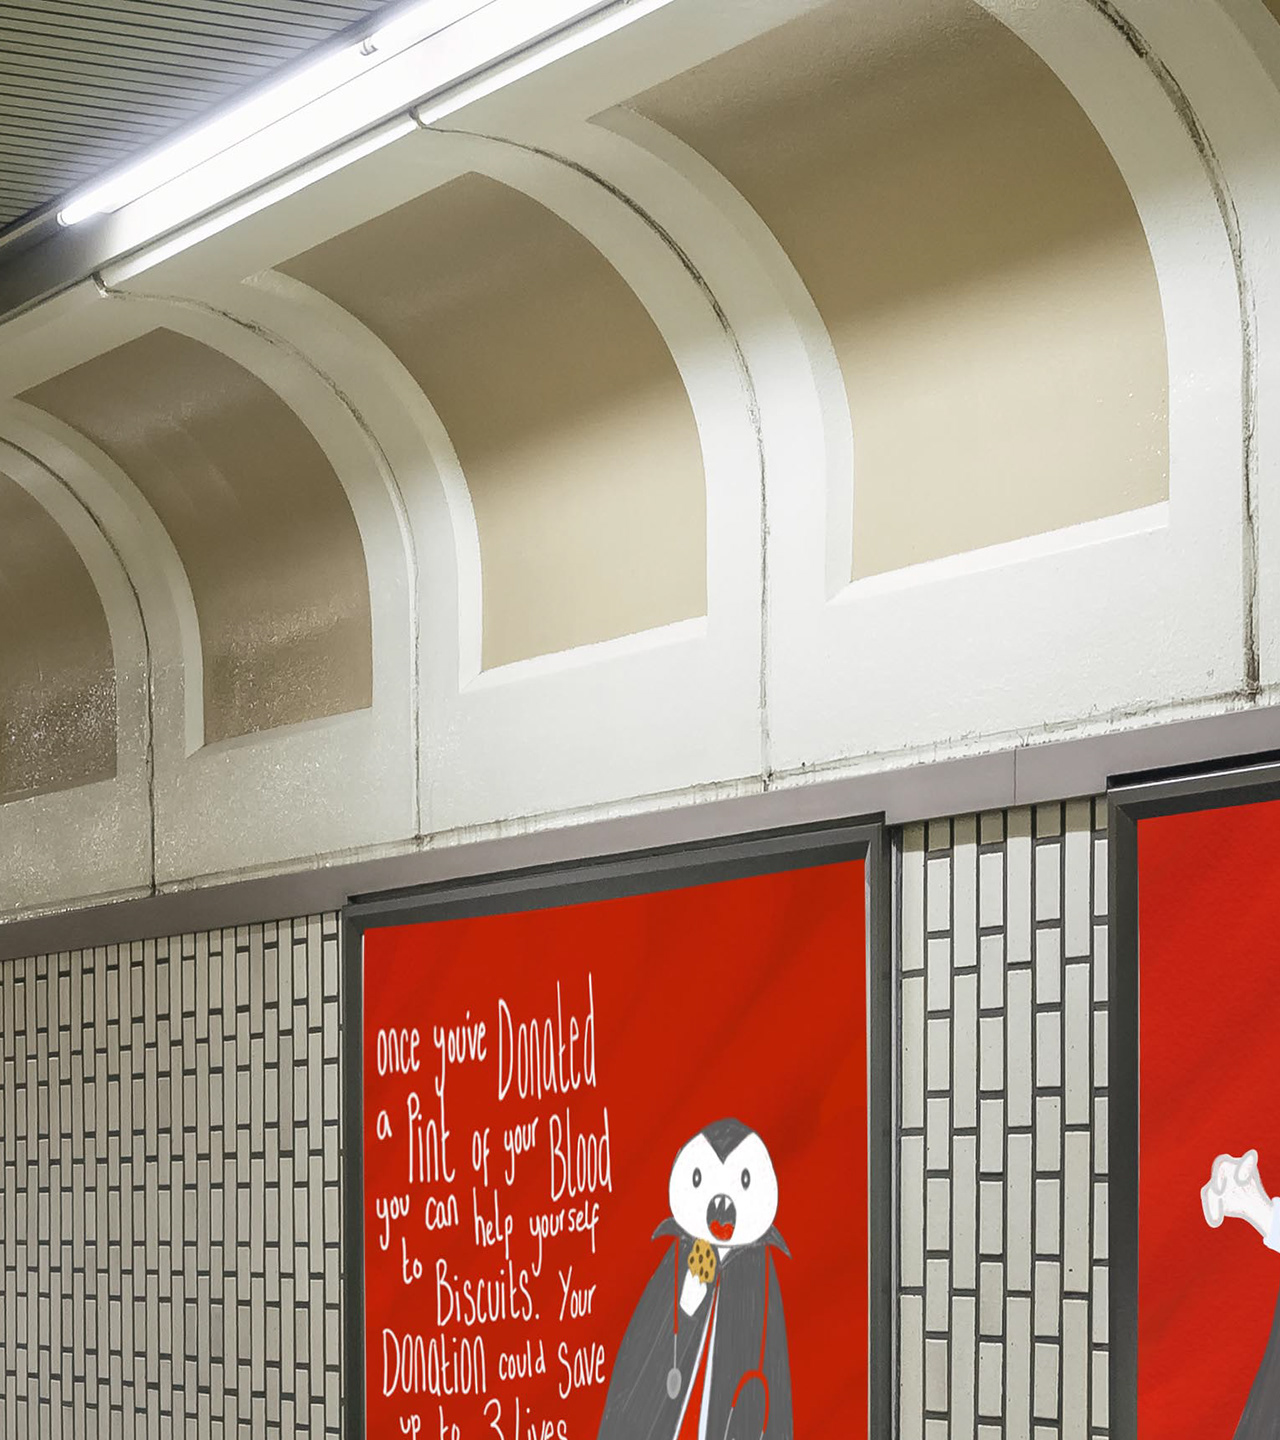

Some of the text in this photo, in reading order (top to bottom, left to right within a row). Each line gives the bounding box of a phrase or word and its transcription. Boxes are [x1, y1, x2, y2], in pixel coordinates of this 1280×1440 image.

[497, 971, 596, 1102] Donated
[376, 1109, 393, 1140] a
[471, 1127, 490, 1187] of
[503, 1116, 539, 1187] your
[548, 1106, 612, 1202] Blood
[376, 1186, 600, 1278] you can help yourself
[402, 1236, 422, 1284] to
[558, 1265, 597, 1321] Your
[382, 1328, 486, 1398] Donation
[499, 1339, 546, 1381] could
